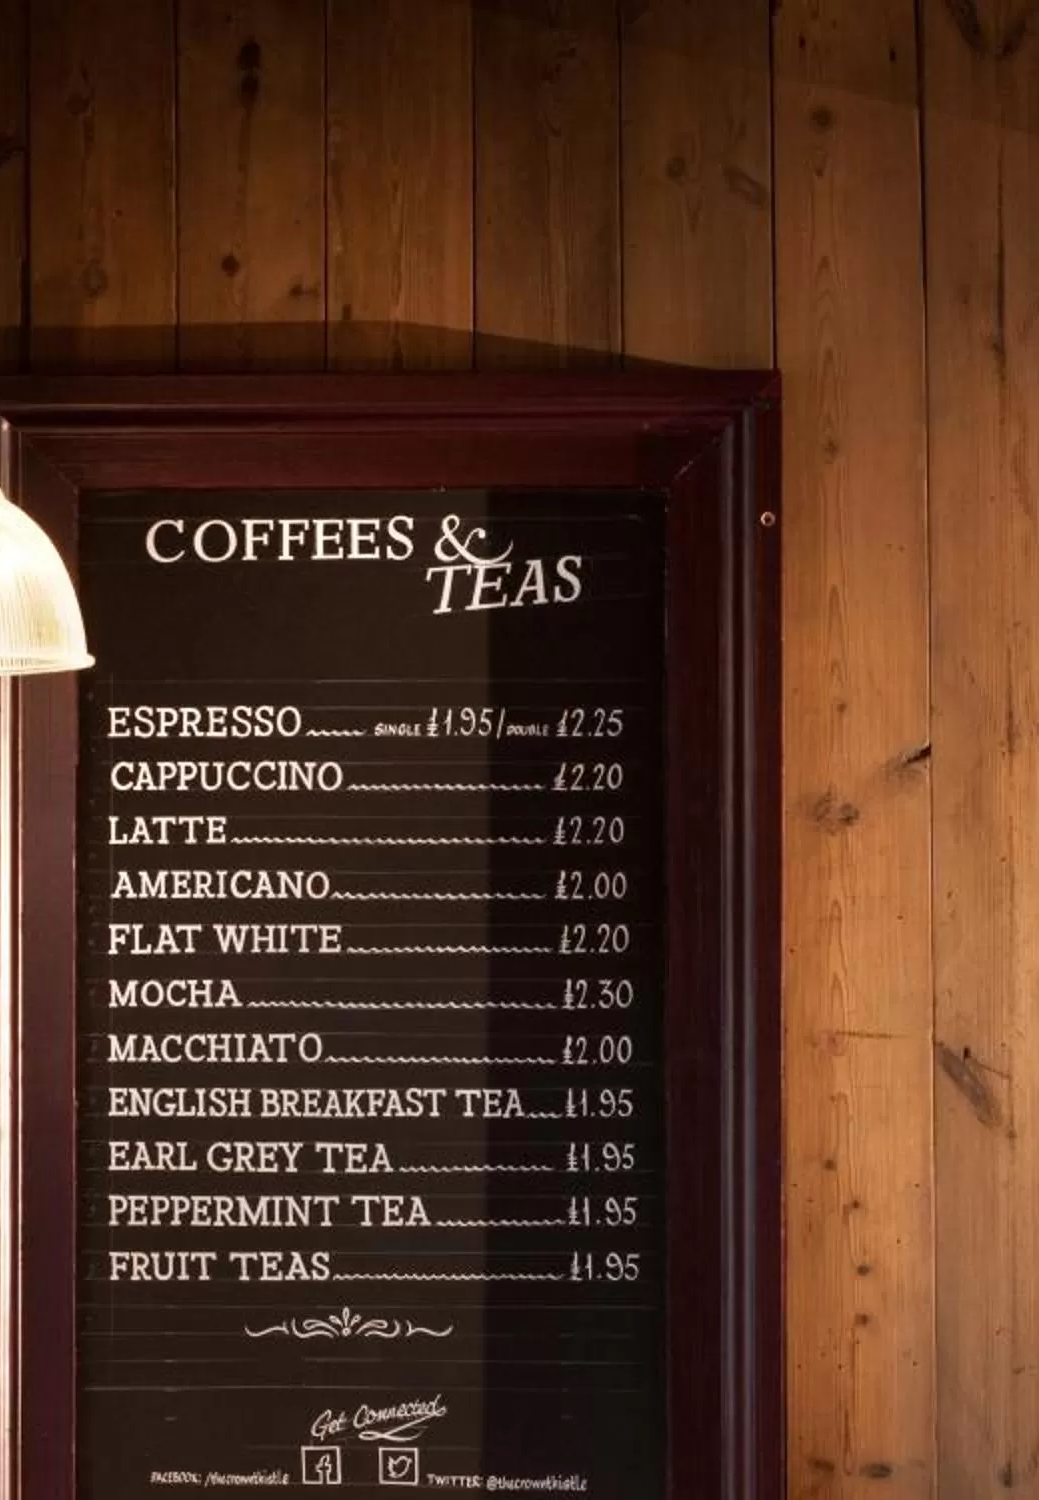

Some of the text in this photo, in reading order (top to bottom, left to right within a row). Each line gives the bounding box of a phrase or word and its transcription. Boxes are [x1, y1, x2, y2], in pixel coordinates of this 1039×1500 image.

[145, 514, 514, 566] COFFEES &
[425, 555, 583, 615] TEAS
[107, 706, 302, 737] ESPRESSO
[374, 722, 422, 737] SINGLE
[506, 724, 549, 737] DOUBLE
[556, 708, 624, 737] £2.25
[110, 762, 623, 791] CAPPUCCINO £2.20
[108, 816, 625, 845] LATTE £2.20
[111, 871, 627, 900] AMERICANO £2.00
[108, 924, 629, 954] FLAT WHITE £2.20
[109, 979, 634, 1009] MOCHA £2.30
[108, 1034, 632, 1065] MACCHIATO £2.00
[108, 1088, 633, 1118] ENGLISH BREAKFAST TEA £1.95
[108, 1143, 636, 1172] EARL GREY TEA £1.95
[108, 1196, 637, 1226] PEPPERMINT TEA £1.95
[109, 1252, 641, 1281] FRUIT TEAS £1.95
[311, 1394, 448, 1440] Get Connected
[151, 1471, 201, 1484] FACEBOOK:
